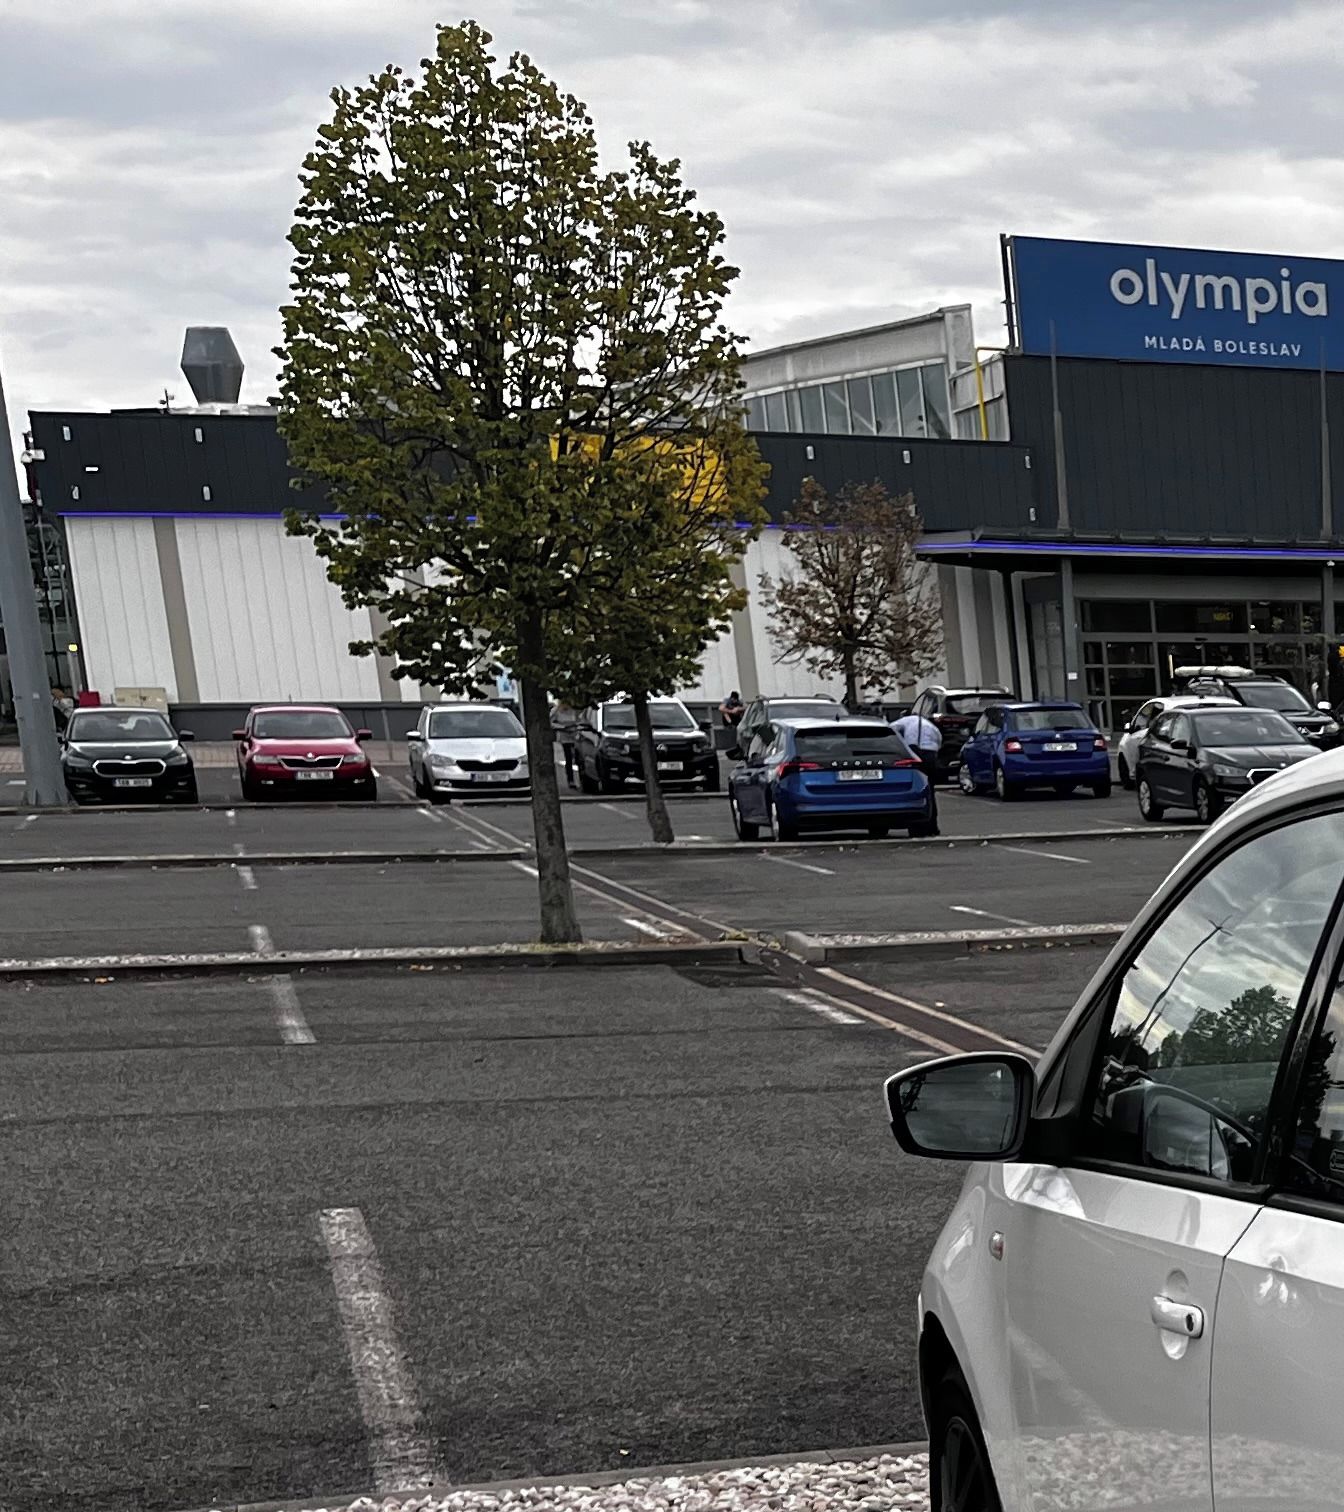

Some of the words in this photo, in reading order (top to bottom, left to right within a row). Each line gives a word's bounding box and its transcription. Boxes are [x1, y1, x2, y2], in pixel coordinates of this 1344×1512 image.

[1110, 258, 1328, 324] olympia
[1144, 335, 1206, 352] MLADÁ
[1213, 339, 1301, 357] BOLESLAV
